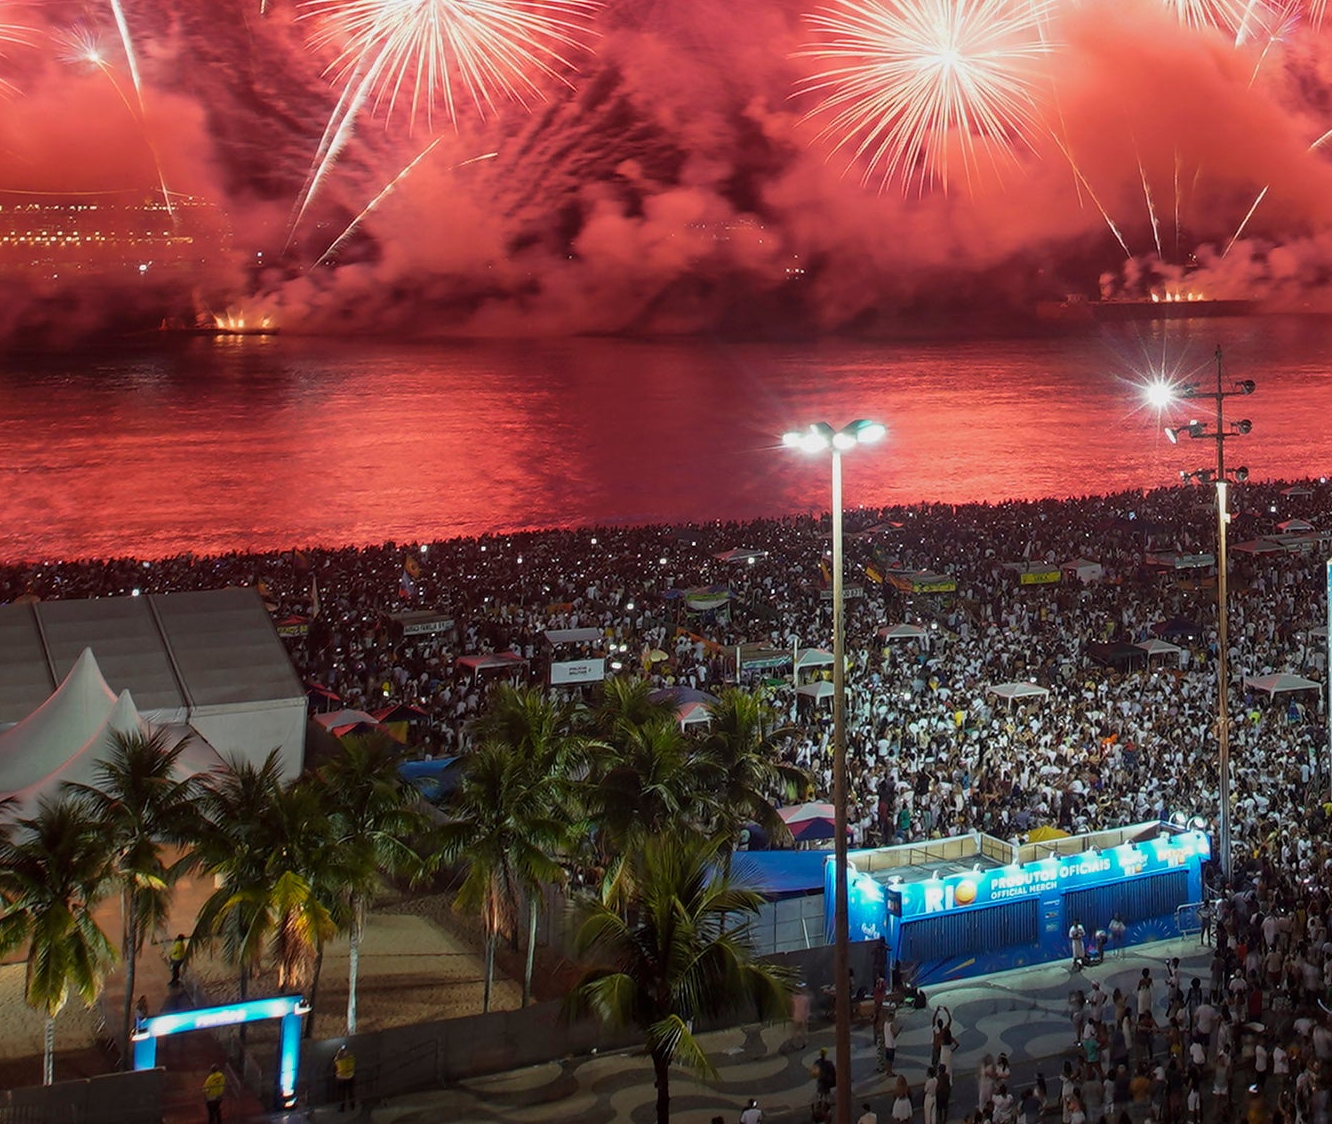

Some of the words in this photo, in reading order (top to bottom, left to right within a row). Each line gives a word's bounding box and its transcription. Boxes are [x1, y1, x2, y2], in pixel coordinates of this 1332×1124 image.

[990, 867, 1057, 890] PRODUTOS
[1059, 858, 1111, 879] OFICIAIS
[924, 879, 978, 913] RIO
[990, 886, 1028, 900] OFFICIAL
[1029, 881, 1058, 896] MERCH
